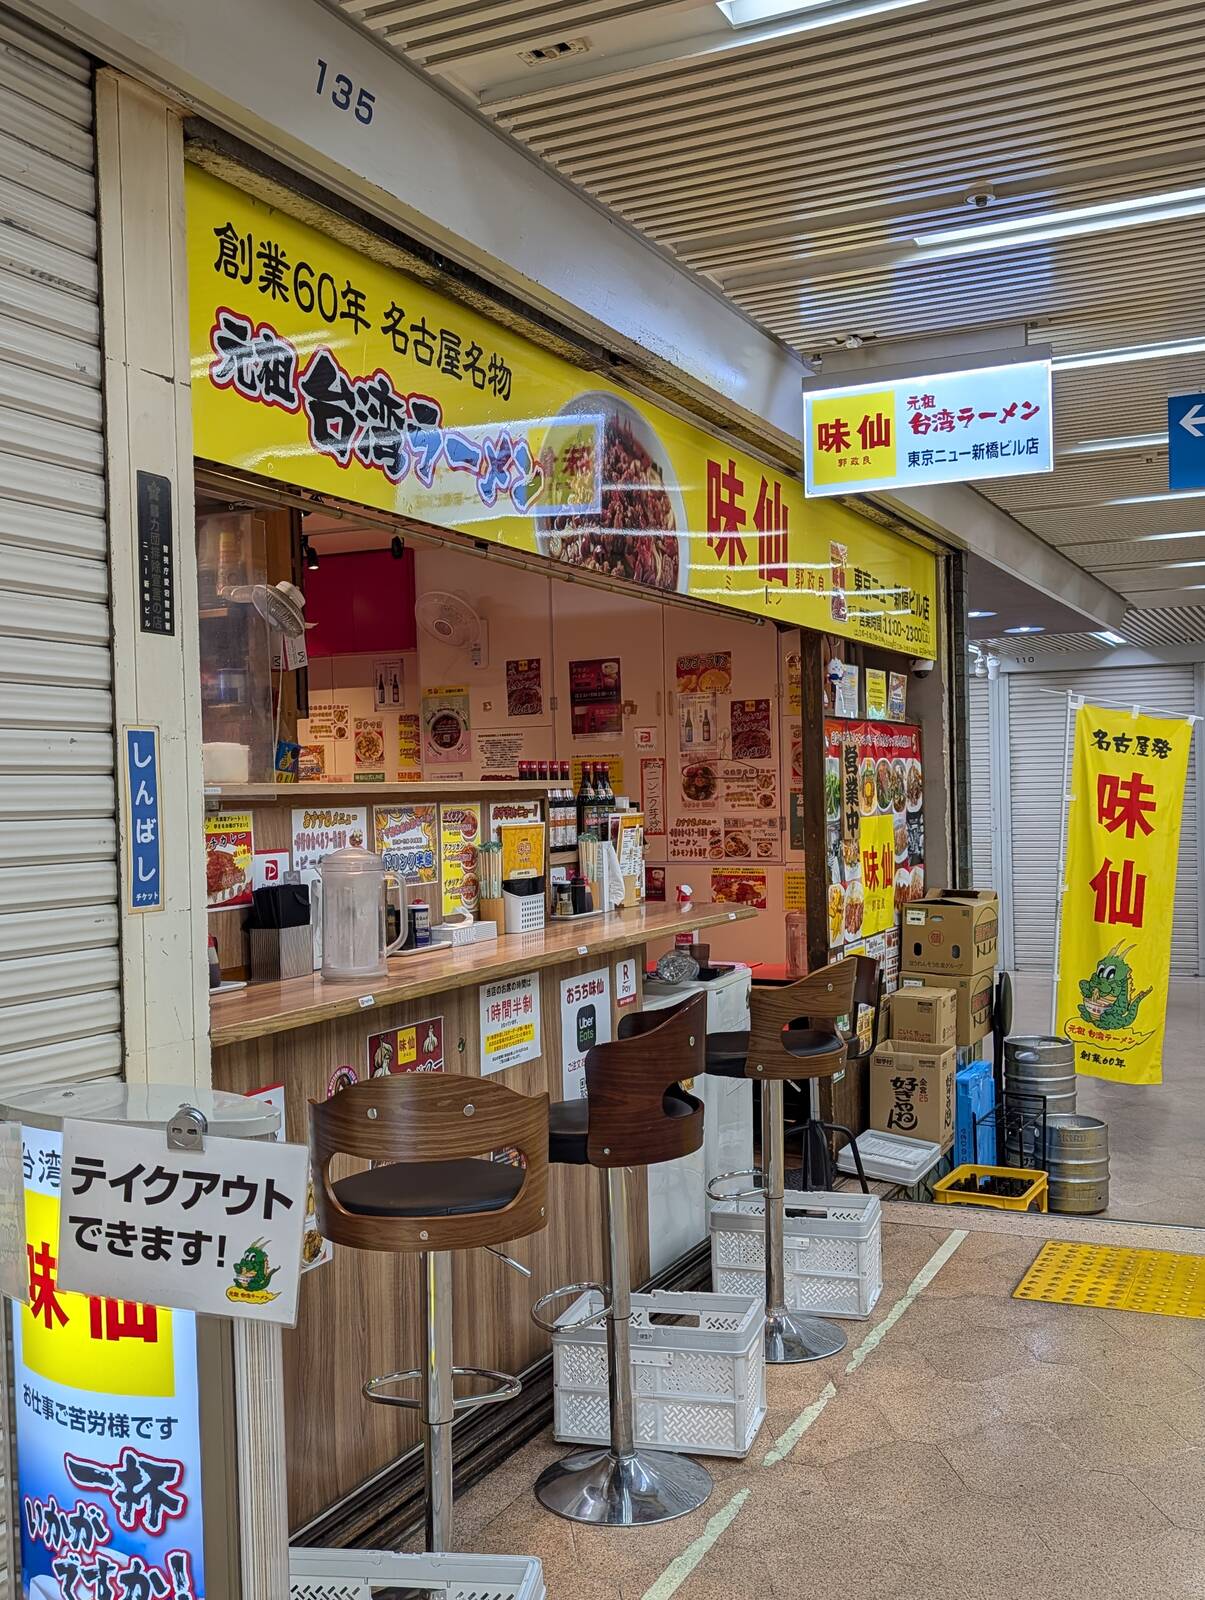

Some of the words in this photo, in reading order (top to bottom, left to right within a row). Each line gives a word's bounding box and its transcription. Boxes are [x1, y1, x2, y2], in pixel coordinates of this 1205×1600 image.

[315, 58, 376, 126] 135
[212, 221, 372, 336] 創業60年
[382, 300, 513, 402] 名古屋名物
[210, 309, 299, 411] 元祖
[300, 348, 543, 512] 台湾ラーメン
[906, 394, 937, 411] 元祖
[908, 401, 1041, 435] 台湾ラーメン
[817, 412, 891, 454] 味仙
[907, 437, 1040, 468] 東京ニュー新橋ビル店
[837, 455, 873, 468] 郭政良
[706, 458, 789, 588] 味仙
[1090, 729, 1173, 760] 名古屋発
[133, 742, 157, 883] しんばし
[843, 745, 859, 838] 営業中
[862, 842, 894, 893] 味仙
[1088, 771, 1157, 929] 味仙
[135, 892, 159, 902] チケット
[485, 992, 533, 1024] 1時間半制
[566, 977, 605, 1005] おうち味仙
[578, 1015, 594, 1031] Uber
[578, 1028, 595, 1043] Eats
[1079, 1050, 1127, 1068] 創業60年
[70, 1155, 294, 1220] テイクアウト
[68, 1215, 227, 1268] できます!
[22, 1383, 179, 1441] お仕事ご苦労様です
[65, 1448, 185, 1534] 一杯
[24, 1495, 110, 1551] いかが
